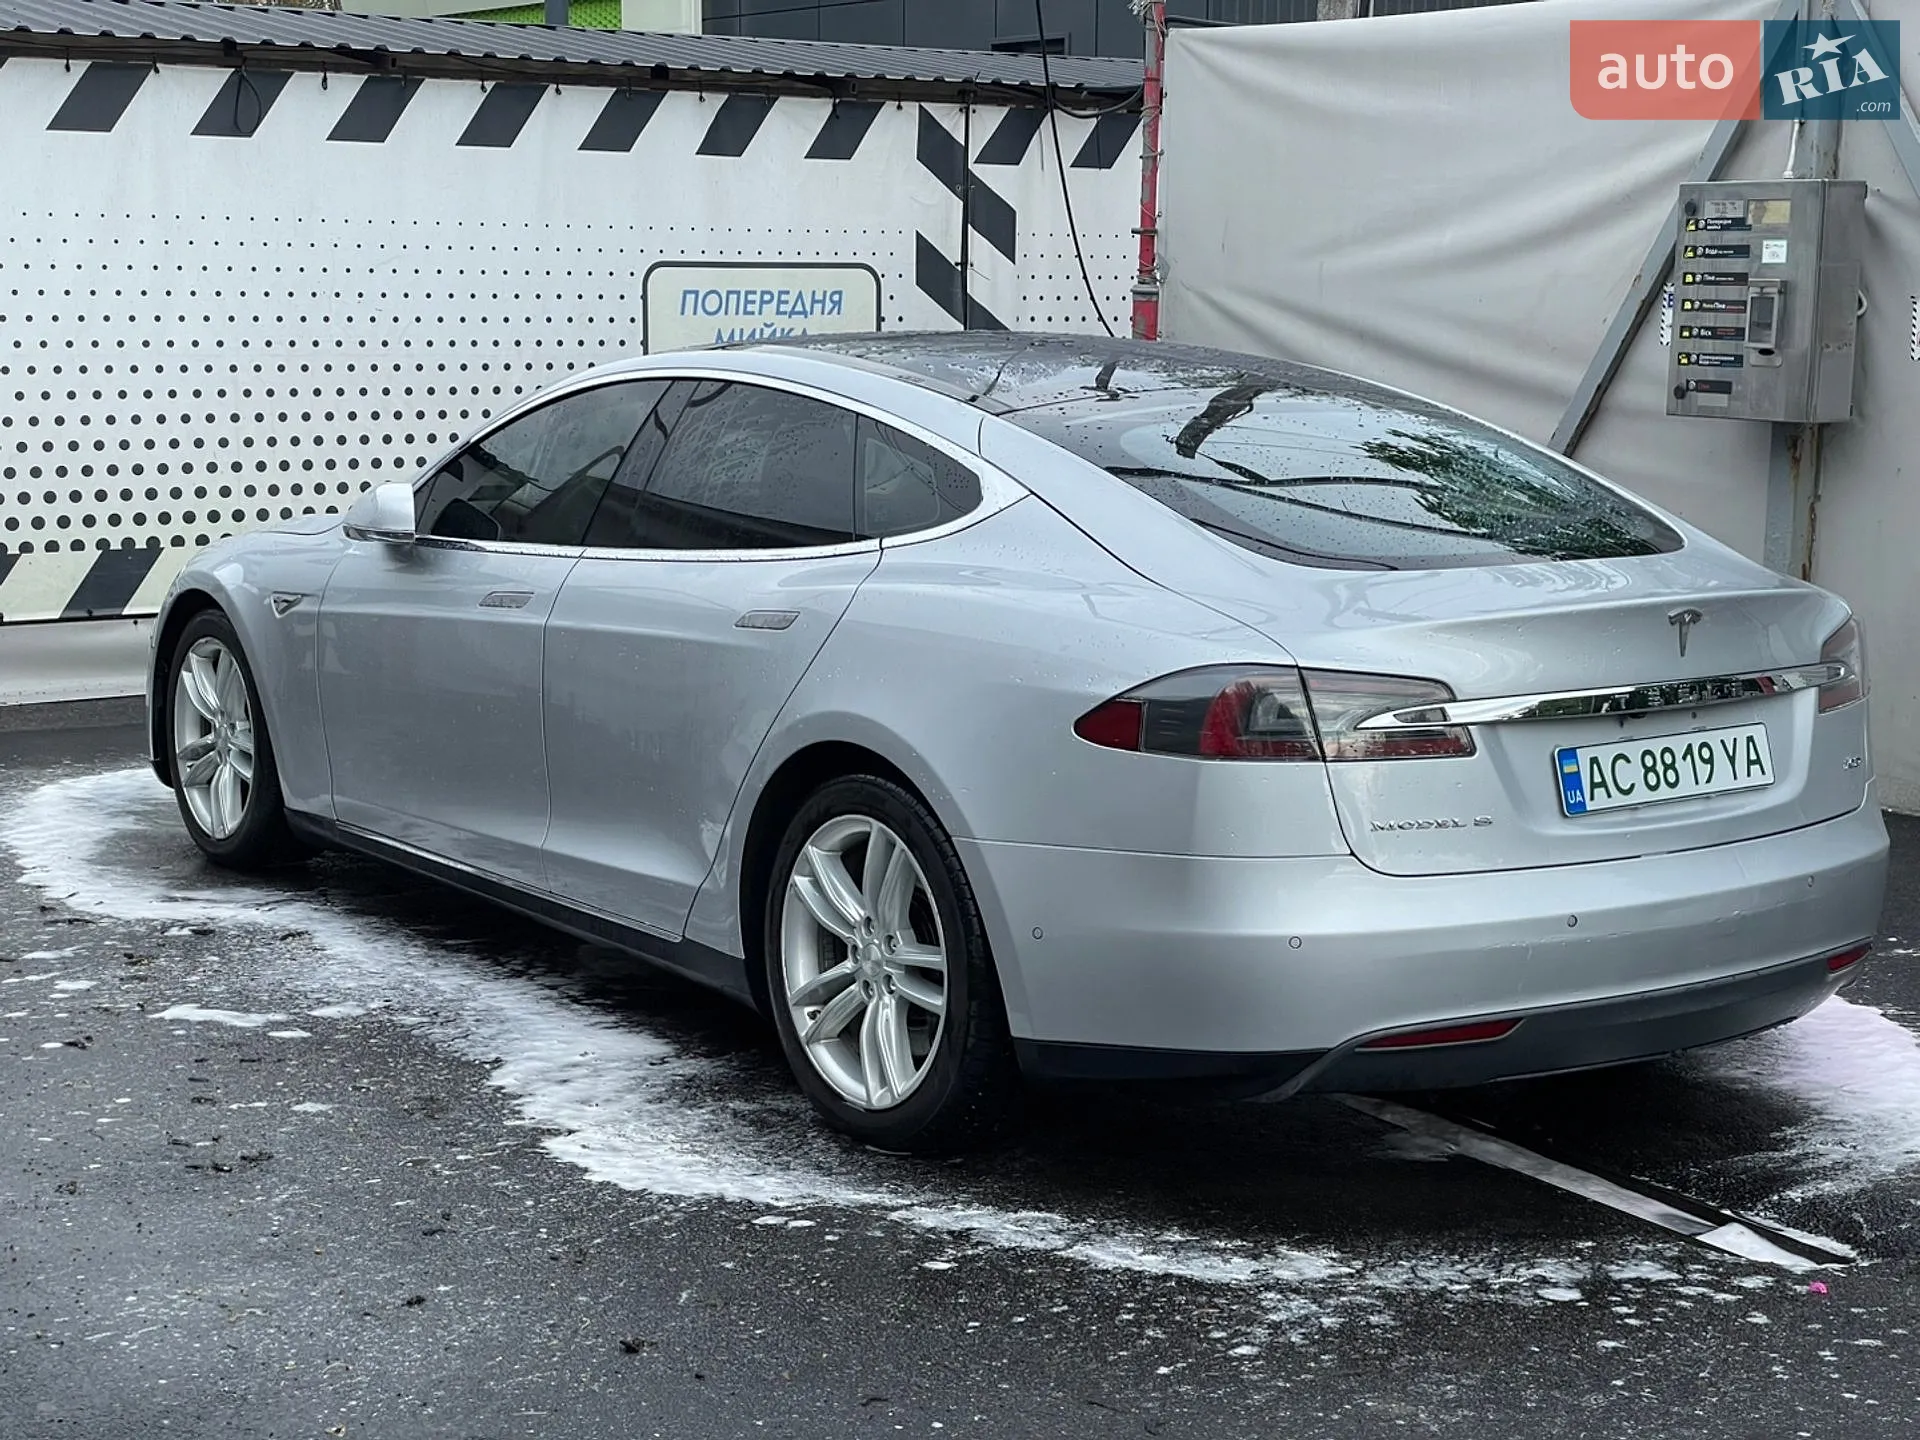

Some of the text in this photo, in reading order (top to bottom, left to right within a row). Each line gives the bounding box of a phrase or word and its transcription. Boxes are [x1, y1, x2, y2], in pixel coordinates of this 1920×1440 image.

[680, 289, 844, 319] ПОПЕРЕДНЯ
[1588, 734, 1767, 802] AC 8819 YA
[1566, 790, 1584, 804] UA
[1370, 814, 1494, 832] MODEL S
